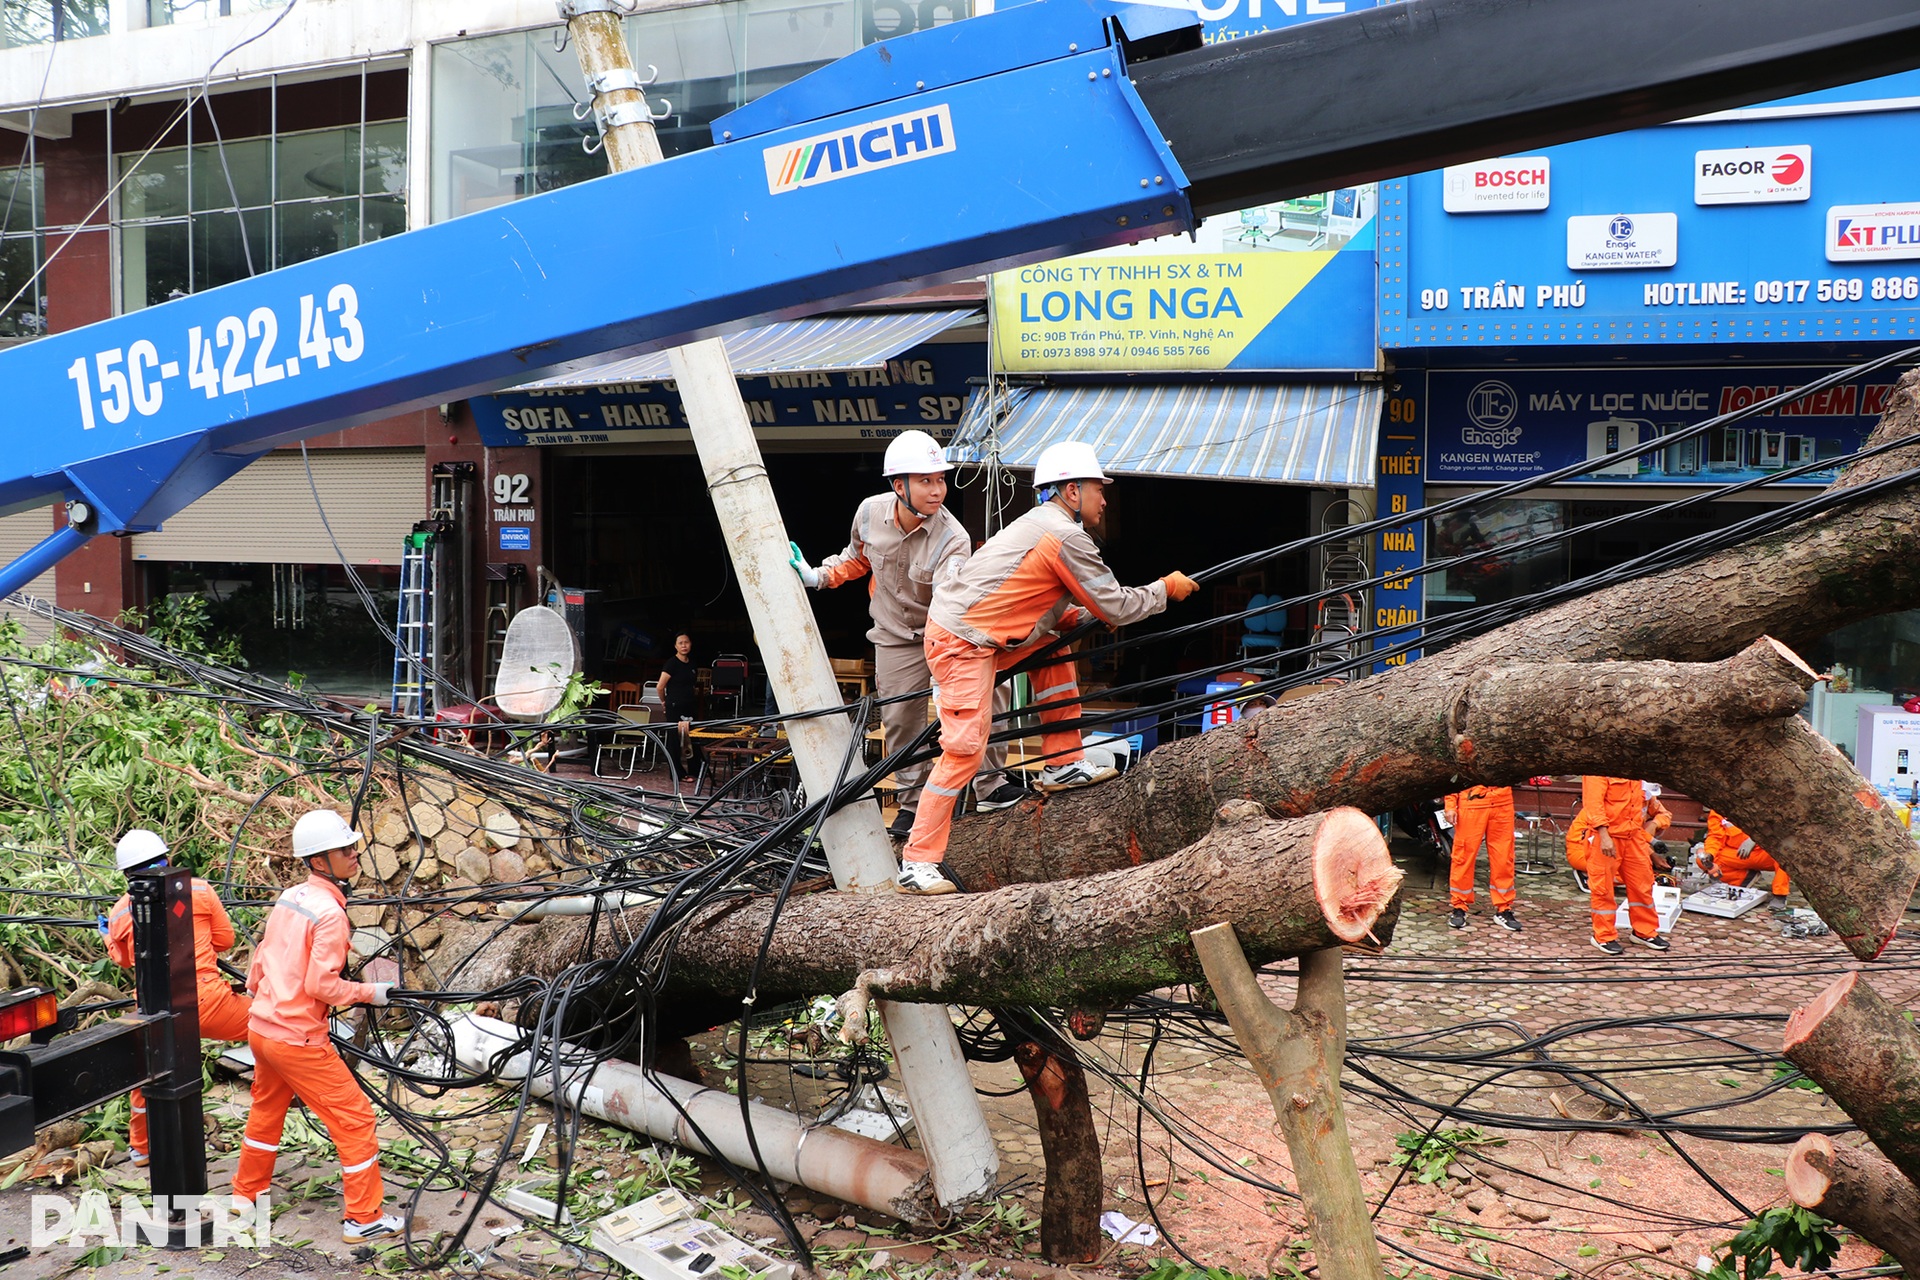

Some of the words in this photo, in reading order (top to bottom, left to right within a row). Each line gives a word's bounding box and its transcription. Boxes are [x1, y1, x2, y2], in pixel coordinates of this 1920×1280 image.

[803, 114, 944, 180] AICHI
[1475, 169, 1545, 187] BOSCH
[1702, 161, 1765, 176] FAGOR
[1475, 191, 1514, 200] Invented
[1516, 191, 1530, 199] for
[1531, 190, 1545, 199] life
[1585, 251, 1623, 260] KANGEN
[1606, 240, 1636, 250] Enagic
[1021, 265, 1073, 283] CÔNG
[1079, 267, 1102, 281] TY
[1107, 265, 1161, 280] TNHH
[1167, 264, 1191, 279] SX
[1196, 263, 1210, 278] &
[1215, 263, 1242, 277] TM
[1421, 288, 1449, 310] 90
[1460, 280, 1525, 309] TRẦN
[1537, 280, 1586, 308] PHÚ
[1644, 282, 1746, 305] HOTLINE:
[1754, 280, 1810, 303] 0917
[1817, 278, 1863, 302] 569
[1871, 276, 1918, 300] 886
[1020, 289, 1133, 323] LONG
[1149, 287, 1243, 320] NGA
[1021, 332, 1041, 342] ĐC:
[1044, 331, 1066, 341] 90B
[1099, 329, 1124, 342] Phú,
[1128, 330, 1145, 340] TP.
[1149, 329, 1179, 340] Vinh,
[1183, 329, 1214, 341] Nghệ
[1217, 328, 1234, 339] An
[67, 283, 364, 430] 15C-422.43
[1021, 349, 1040, 358] ĐT:
[1043, 348, 1071, 358] 0973
[1074, 347, 1096, 357] 898
[1099, 347, 1120, 357] 974
[1131, 347, 1160, 356] 0946
[1163, 346, 1185, 355] 585
[1188, 345, 1210, 355] 766
[812, 397, 888, 423] NAIL
[1389, 398, 1416, 424] 90
[1529, 390, 1582, 411] MÁY
[1590, 393, 1634, 415] LỌC
[1642, 389, 1708, 411] NƯỚC
[502, 406, 574, 431] SOFA
[600, 403, 671, 428] HAIR
[579, 433, 609, 443] TP.VINH
[1380, 448, 1421, 475] THIẾT
[1439, 464, 1460, 472] Change
[1440, 453, 1491, 463] KANGEN
[494, 474, 529, 504] 92
[518, 506, 535, 522] PHÚ
[1383, 527, 1415, 551] NHÀ
[1377, 604, 1417, 627] CHÂU
